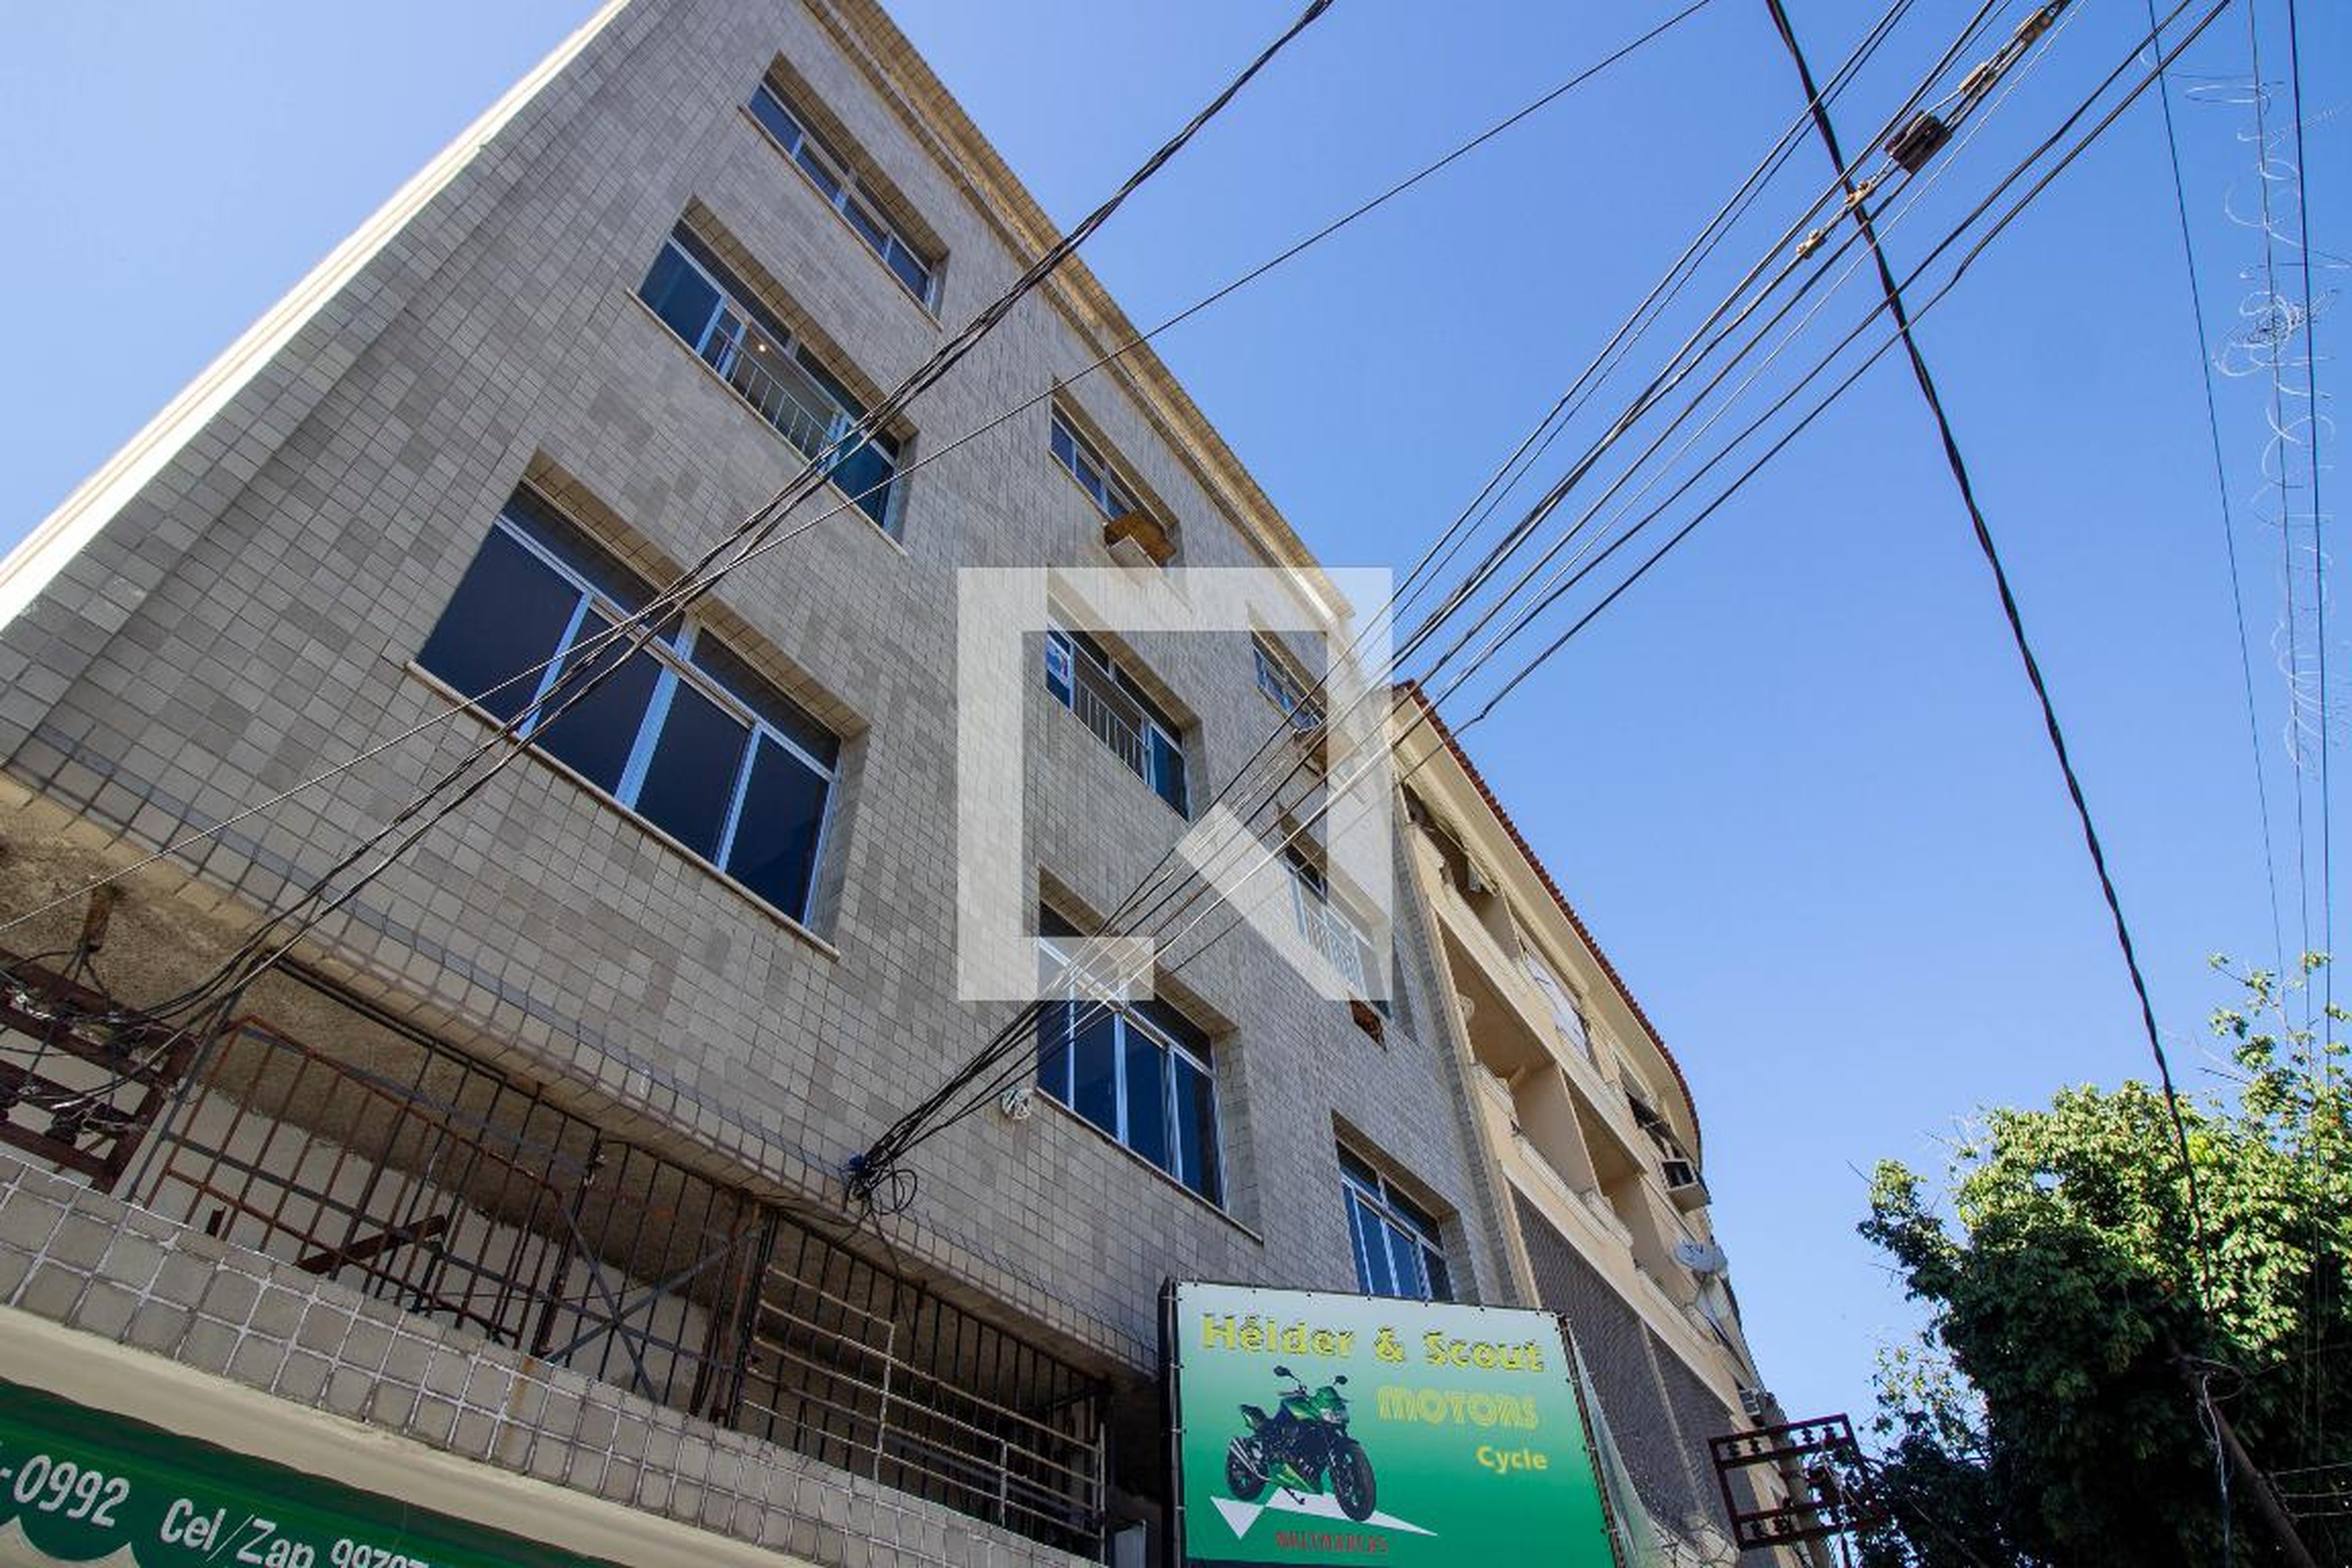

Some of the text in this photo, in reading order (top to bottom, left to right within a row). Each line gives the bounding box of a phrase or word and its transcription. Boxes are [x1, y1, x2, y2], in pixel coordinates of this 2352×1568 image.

[1374, 1326, 1406, 1363] &
[1422, 1330, 1544, 1372] Scout
[1376, 1385, 1539, 1430] MOTORS
[1475, 1444, 1548, 1475] Cycle
[0, 1441, 130, 1528] -0992
